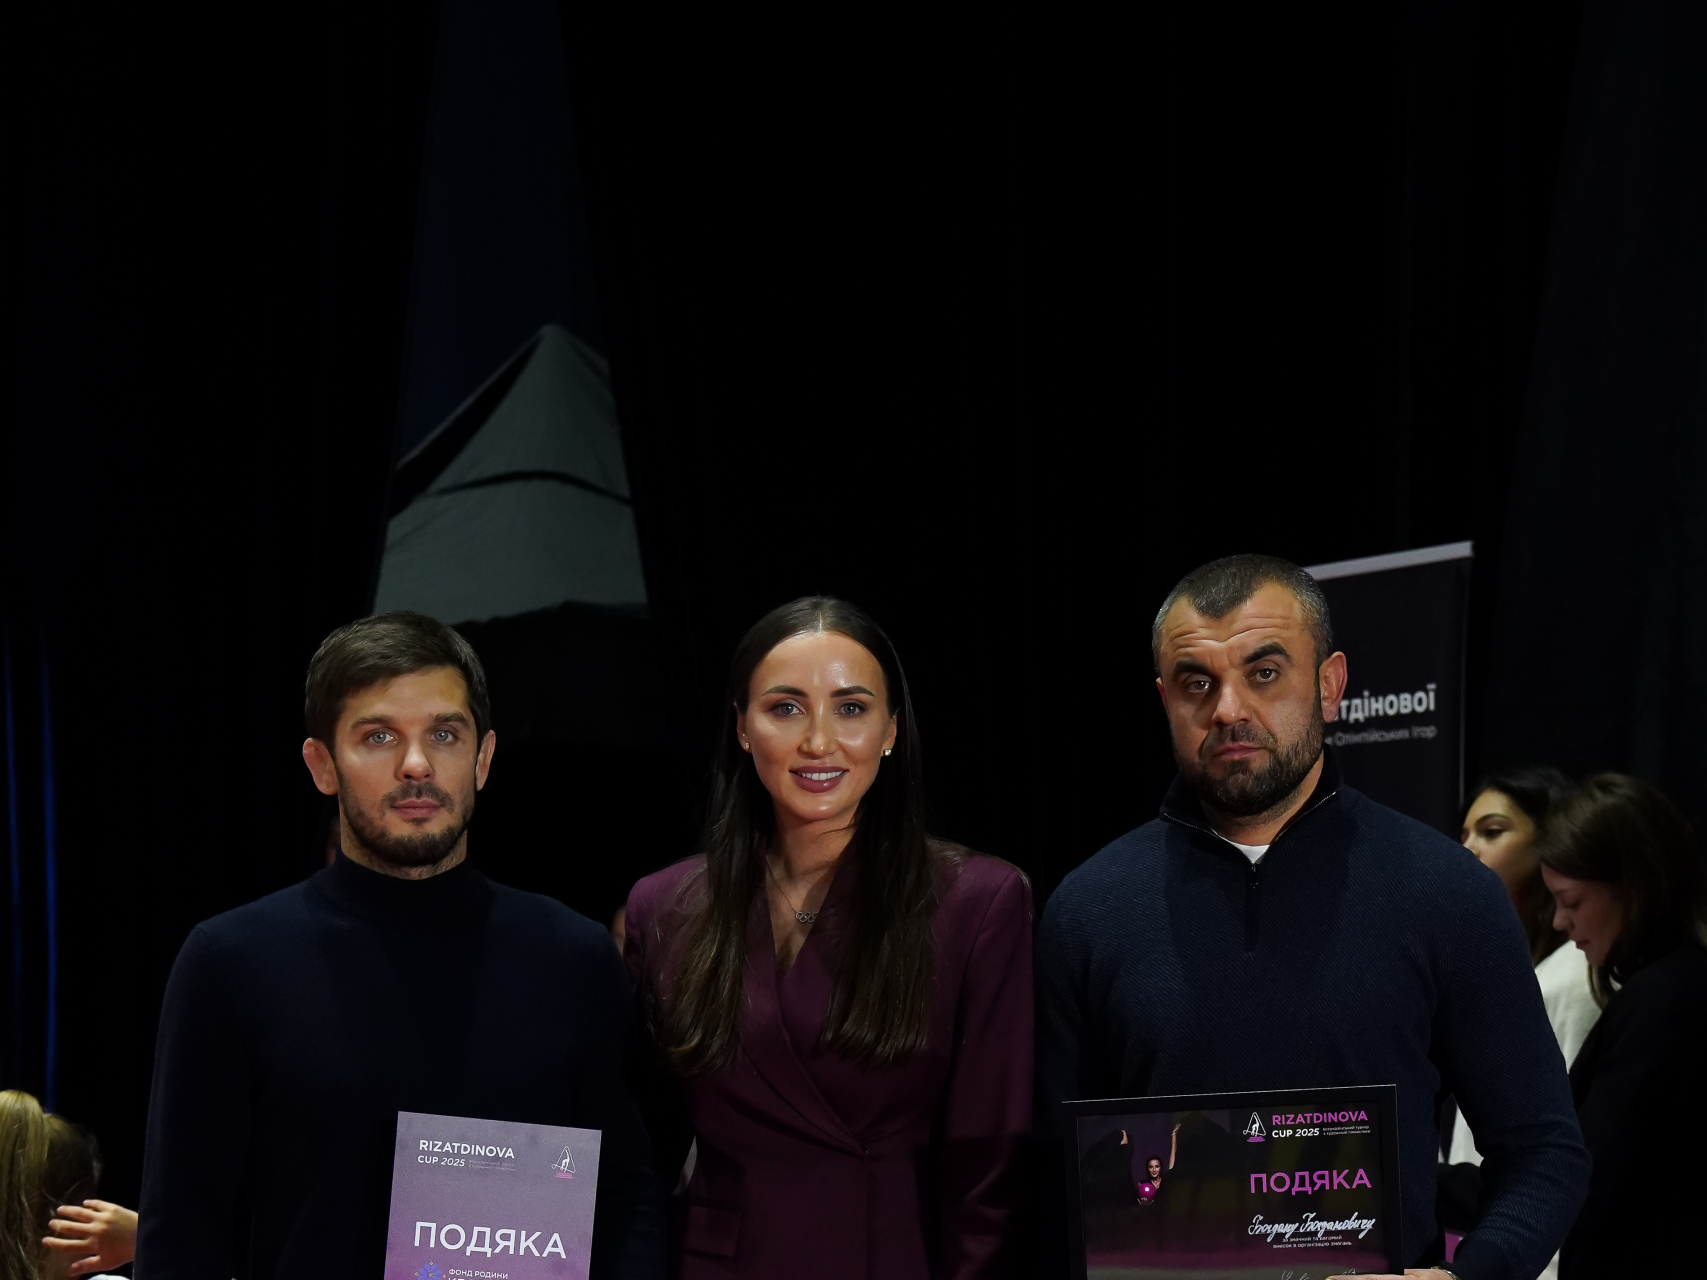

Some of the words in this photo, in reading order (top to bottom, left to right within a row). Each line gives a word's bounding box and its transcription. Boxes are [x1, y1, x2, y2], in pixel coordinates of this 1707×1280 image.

[1335, 682, 1438, 724] тдінової
[1272, 1110, 1368, 1126] RIZATDINOVA
[1271, 1129, 1293, 1138] CUP
[1294, 1127, 1320, 1137] 2025
[419, 1139, 515, 1159] RIZATDINOVA
[417, 1155, 439, 1164] CUP
[440, 1157, 466, 1167] 2025
[1250, 1168, 1372, 1195] ПОДЯКА
[414, 1221, 567, 1259] ПОДЯКА
[448, 1268, 473, 1278] ФОНД
[474, 1270, 509, 1279] РОДИНИ
